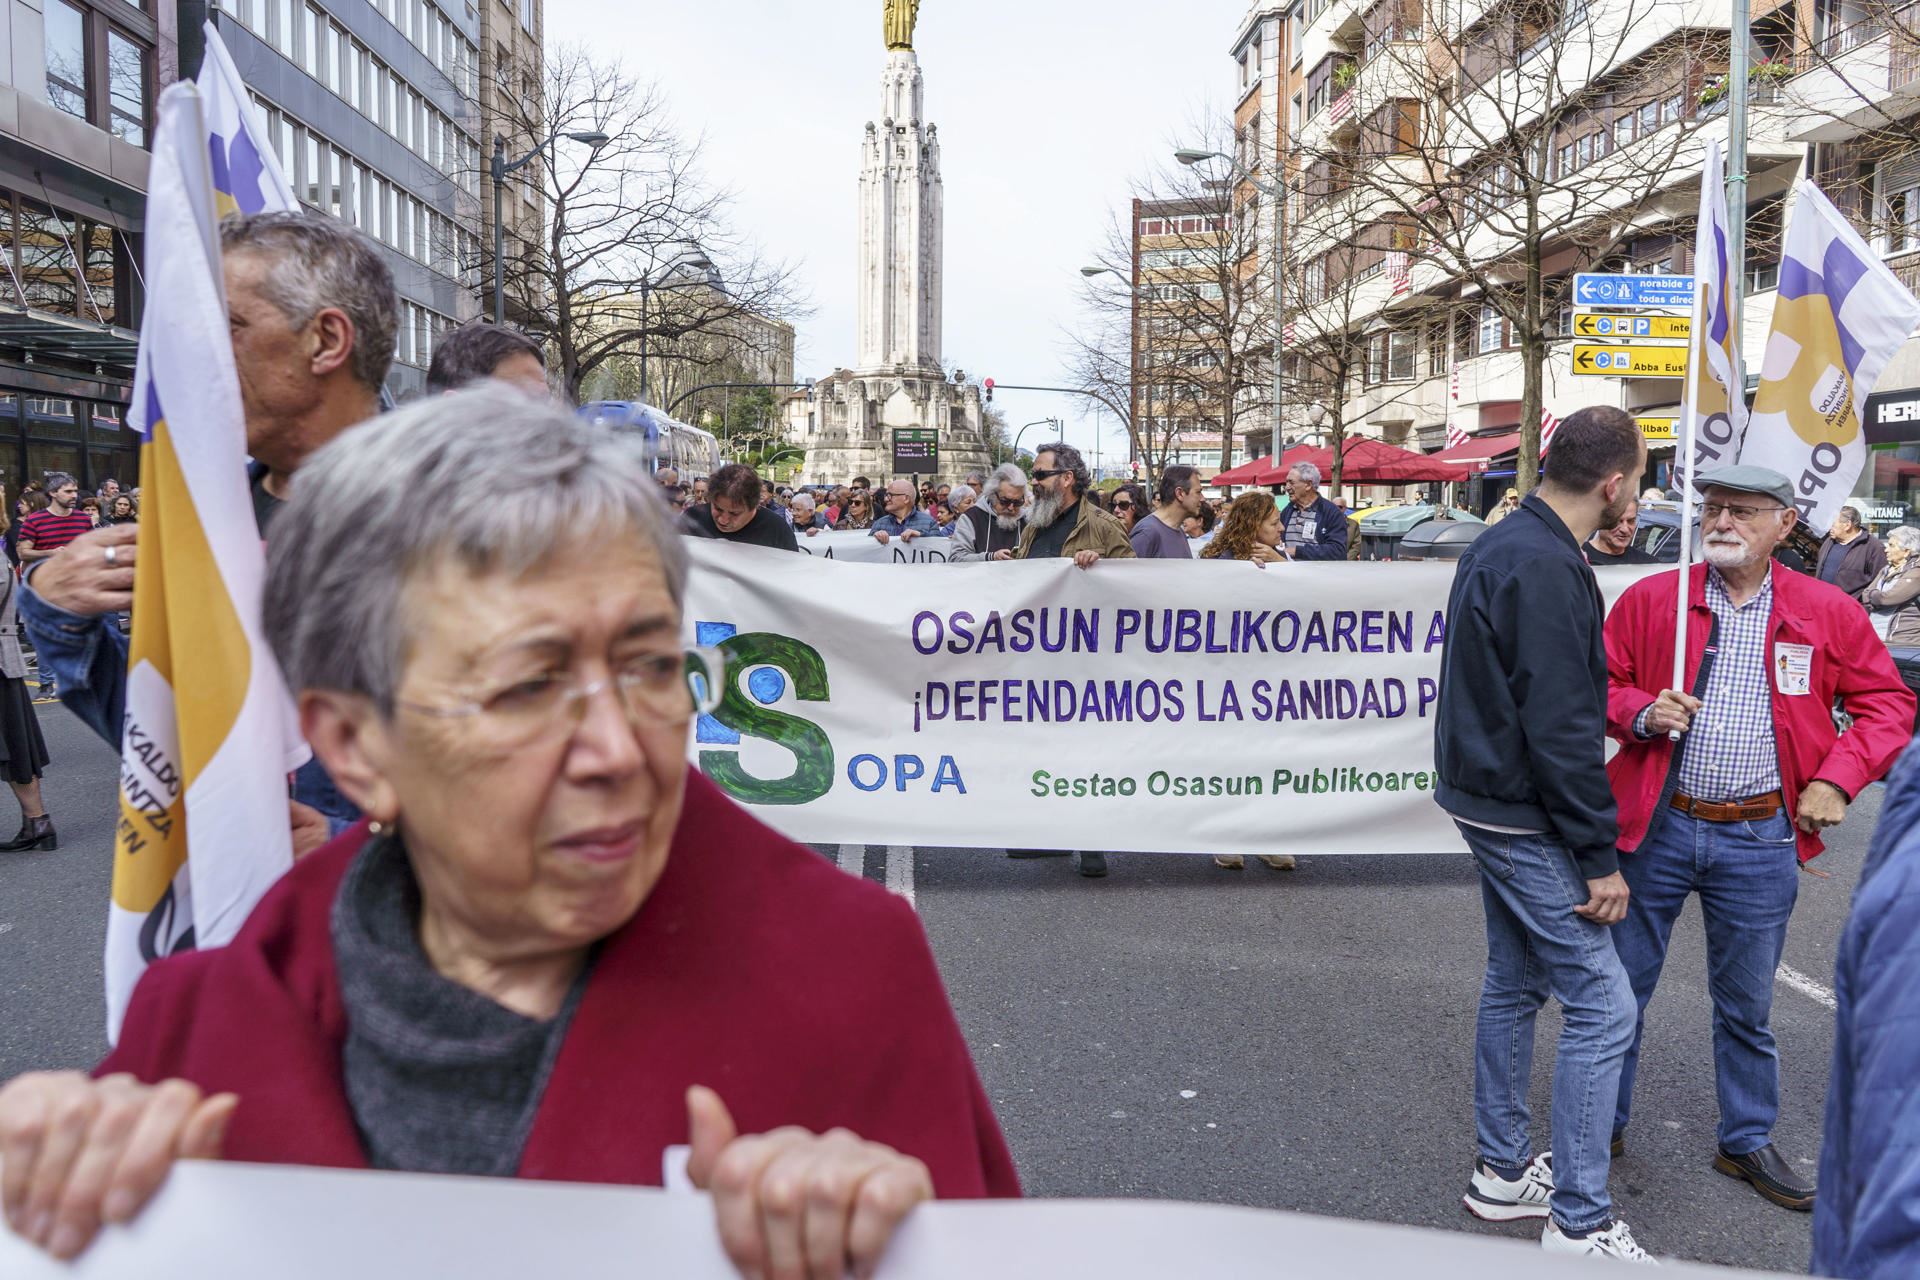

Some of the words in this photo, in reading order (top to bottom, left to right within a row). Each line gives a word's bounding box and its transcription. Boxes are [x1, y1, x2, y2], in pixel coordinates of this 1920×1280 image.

[1640, 280, 1683, 288] norabide
[1639, 295, 1665, 303] todas
[1633, 363, 1659, 371] Abba
[1639, 424, 1669, 432] ilbao
[912, 607, 1100, 655] OSASUN
[1115, 608, 1413, 653] PUBLIKOAREN
[913, 678, 1185, 732] ¡DEFENDAMOS
[1197, 679, 1244, 721] LA
[1251, 677, 1407, 722] SANIDAD
[1417, 677, 1438, 718] P
[122, 713, 180, 797] KALDO
[1030, 769, 1137, 798] Sestao
[1147, 770, 1263, 797] Osasun
